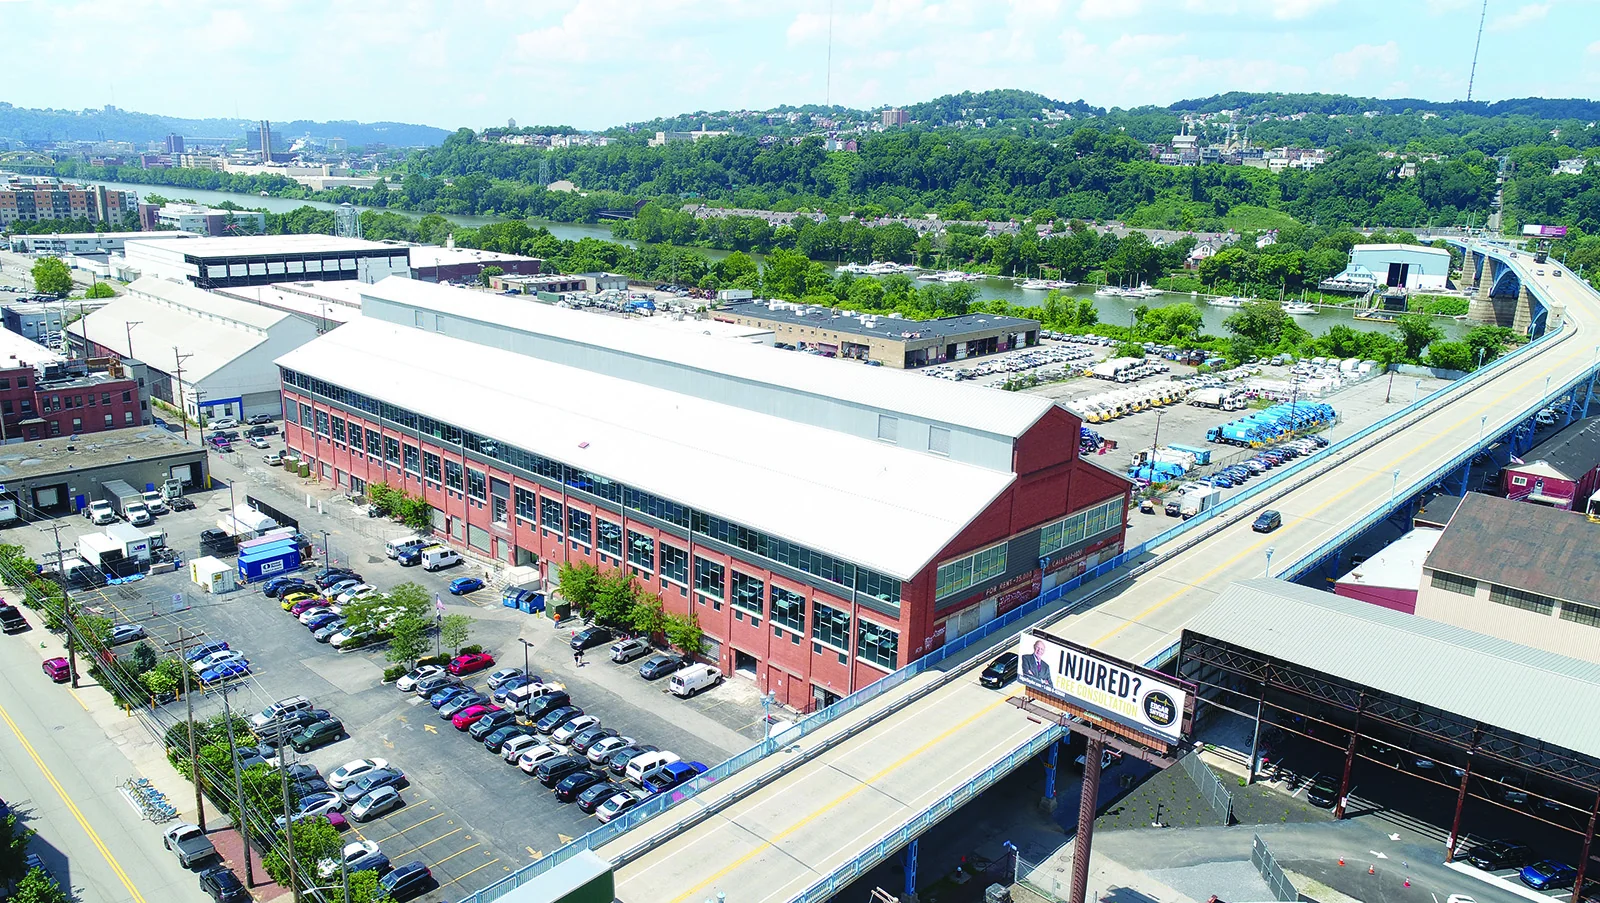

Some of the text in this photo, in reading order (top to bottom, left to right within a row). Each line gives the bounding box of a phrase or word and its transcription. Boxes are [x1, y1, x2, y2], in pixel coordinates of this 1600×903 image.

[985, 586, 997, 596] FOR
[1058, 650, 1142, 703] INJURED?
[1055, 676, 1076, 694] FREE
[1077, 684, 1138, 718] CONSULTATION
[1150, 701, 1169, 714] EDGAR
